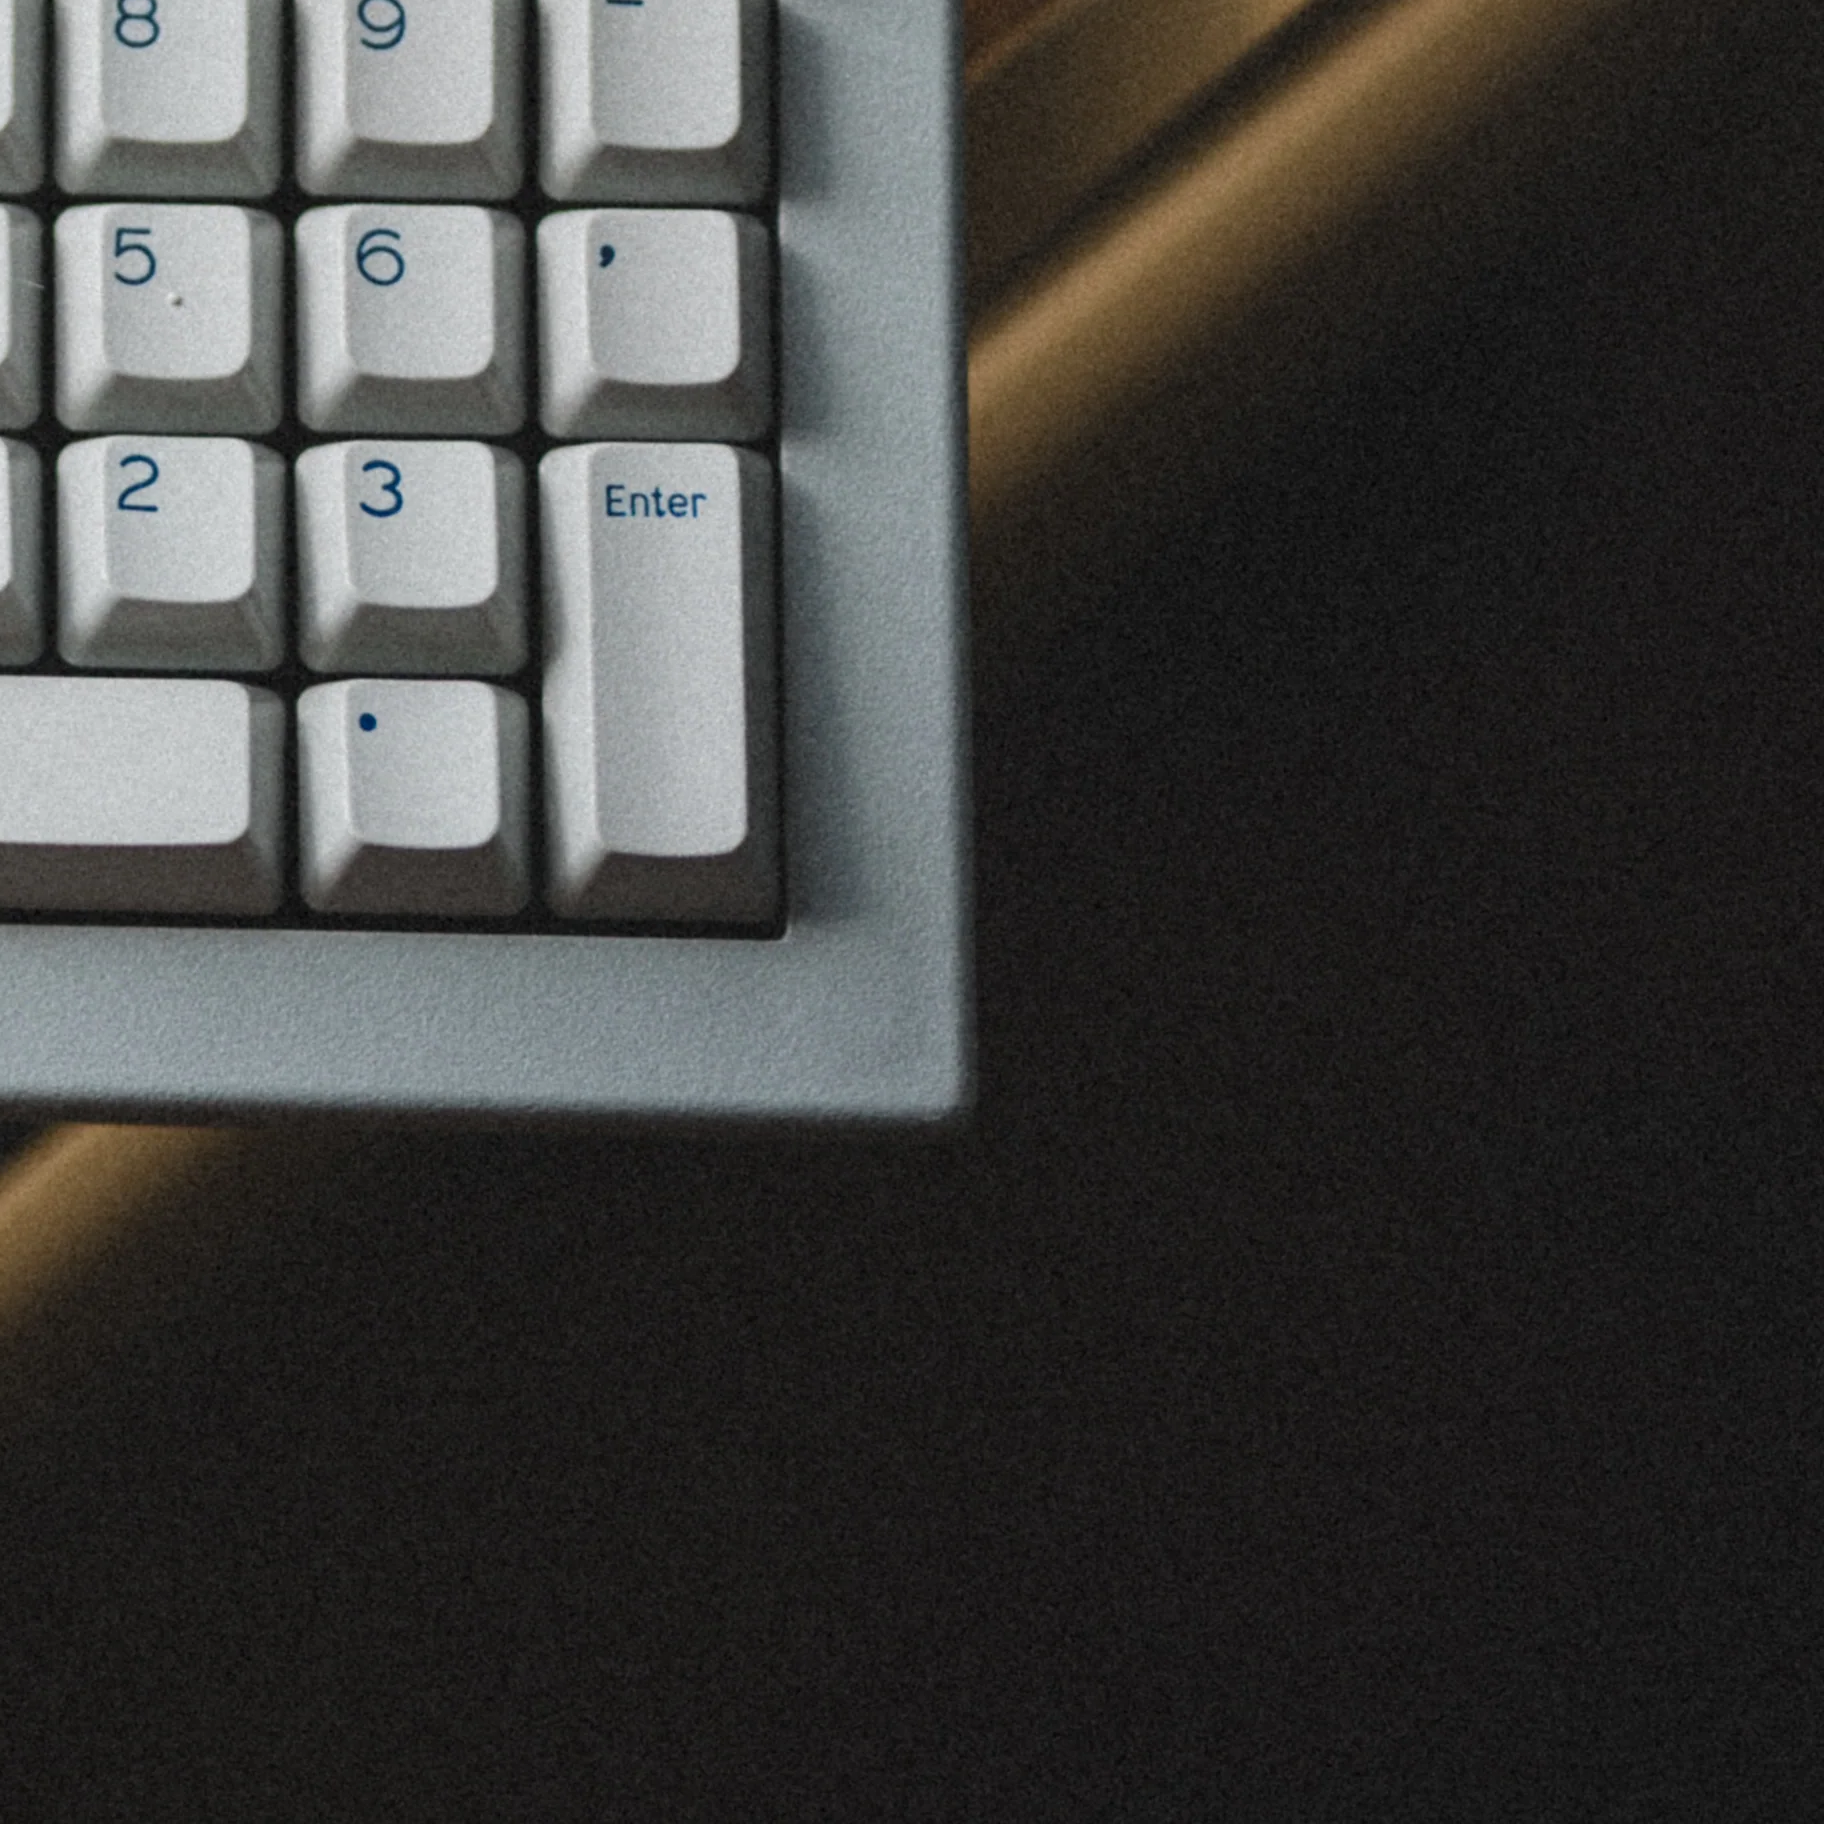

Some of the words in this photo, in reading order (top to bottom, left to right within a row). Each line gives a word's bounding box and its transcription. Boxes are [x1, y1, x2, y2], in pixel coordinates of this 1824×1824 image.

[112, 225, 159, 288] 5
[353, 226, 407, 289] 6
[115, 452, 161, 514] 2
[358, 458, 405, 520] 3
[603, 482, 707, 520] Enter
